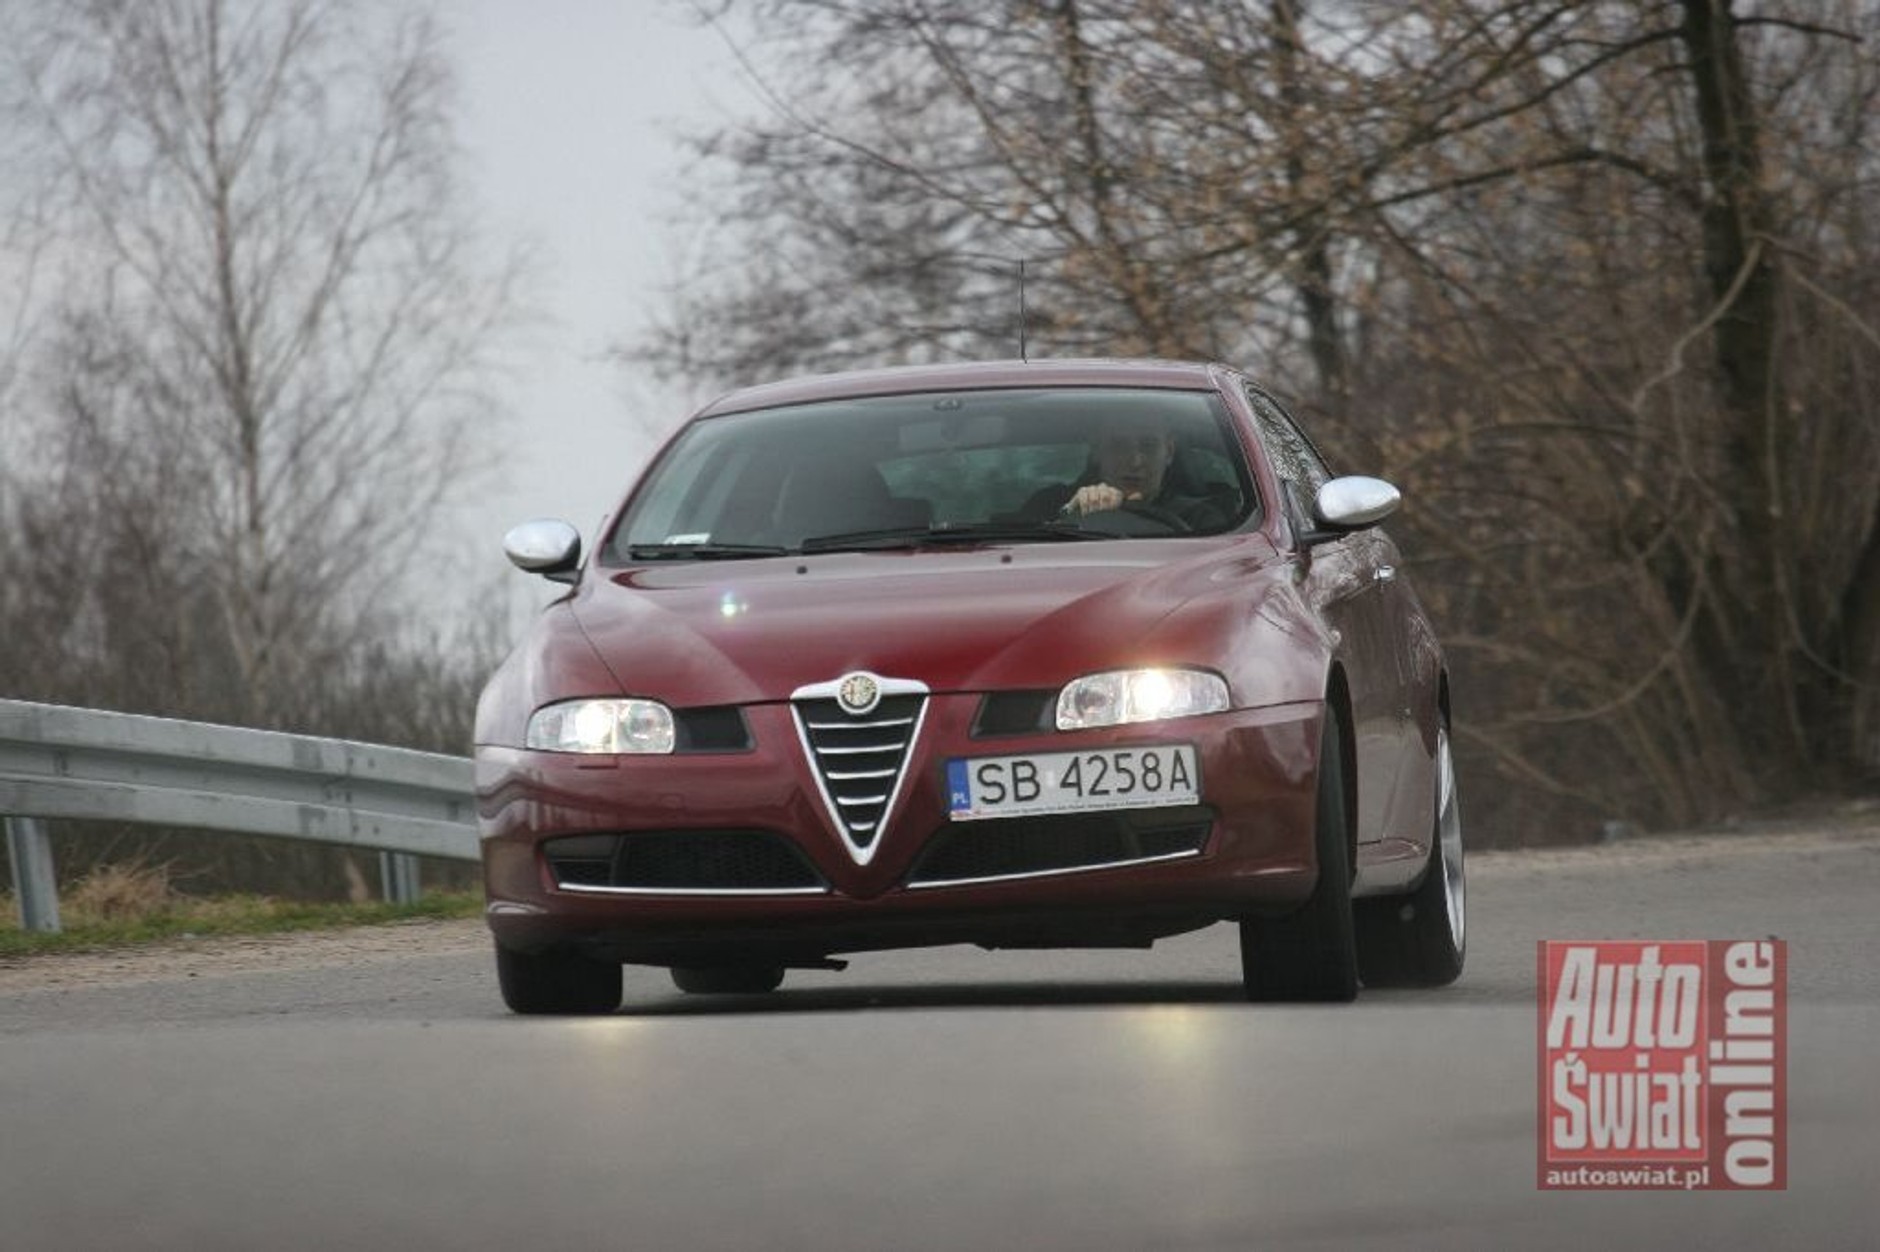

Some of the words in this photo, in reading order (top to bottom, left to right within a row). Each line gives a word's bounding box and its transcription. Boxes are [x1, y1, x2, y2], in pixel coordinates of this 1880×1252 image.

[976, 760, 1041, 804] SB
[1059, 749, 1191, 797] 4258A
[953, 792, 967, 804] PL
